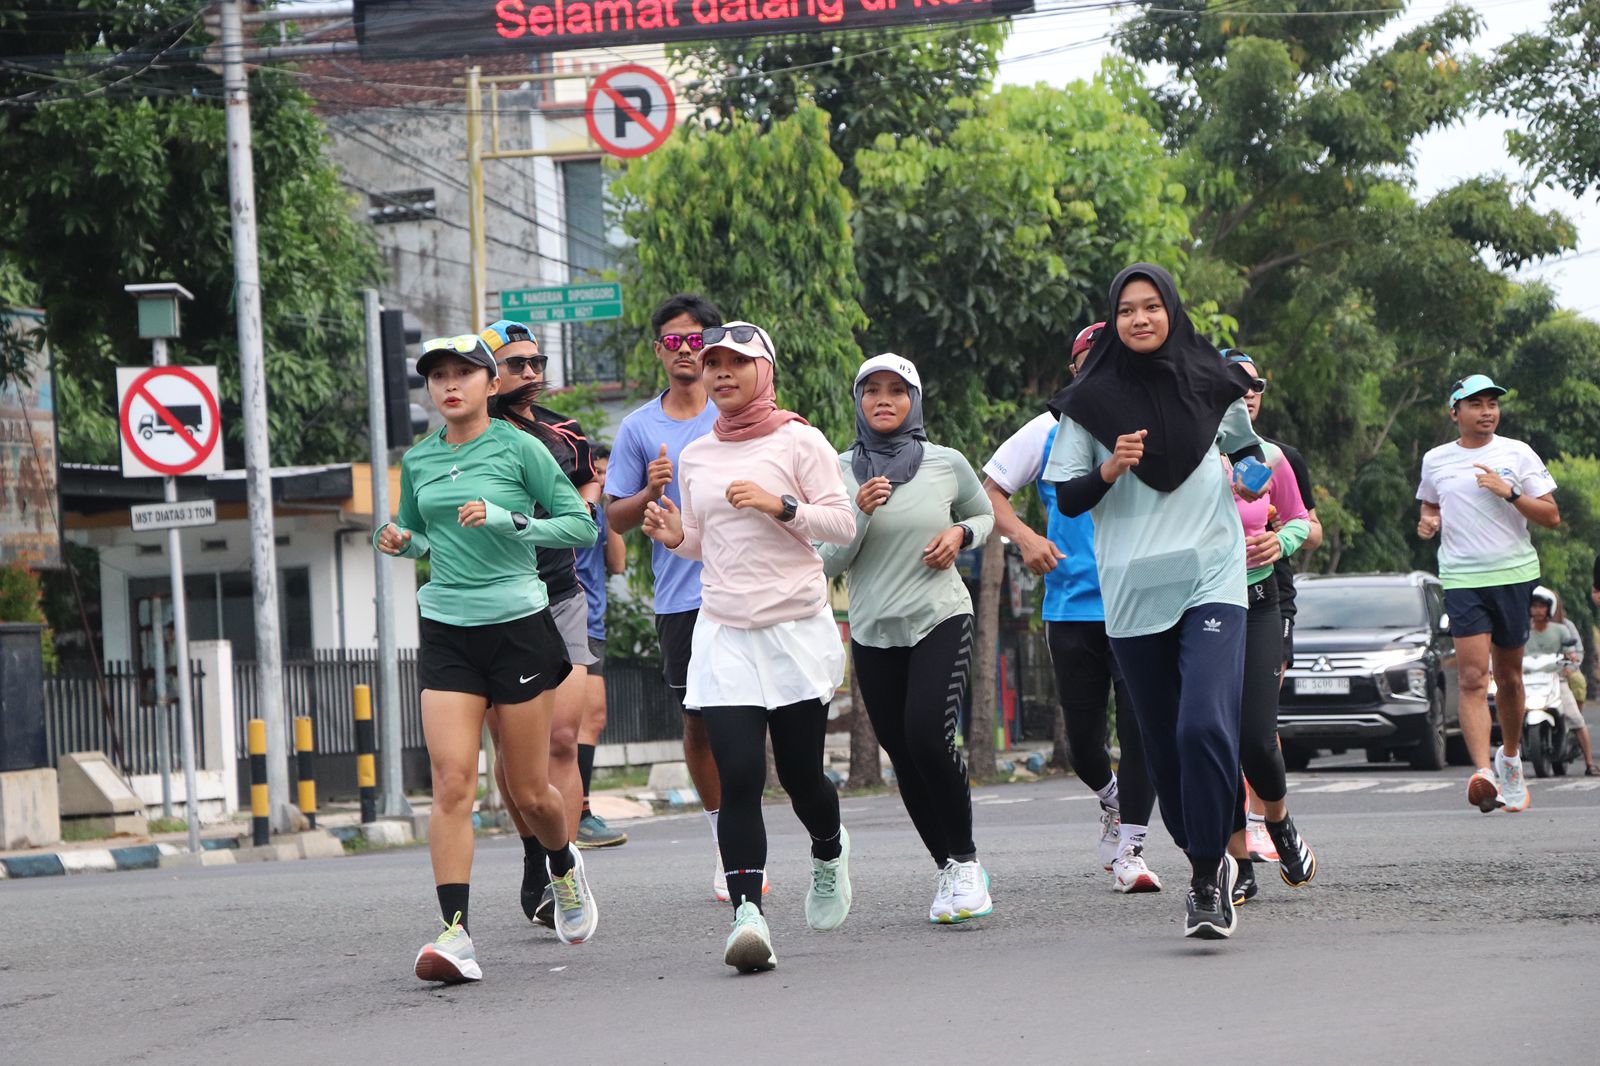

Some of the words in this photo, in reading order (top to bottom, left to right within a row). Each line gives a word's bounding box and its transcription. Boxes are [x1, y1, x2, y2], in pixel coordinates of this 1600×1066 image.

[495, 0, 680, 38] Selamat
[614, 86, 652, 138] P
[135, 511, 153, 524] MST
[155, 509, 186, 522] DIATAS
[187, 508, 192, 519] 3
[194, 506, 212, 519] TON
